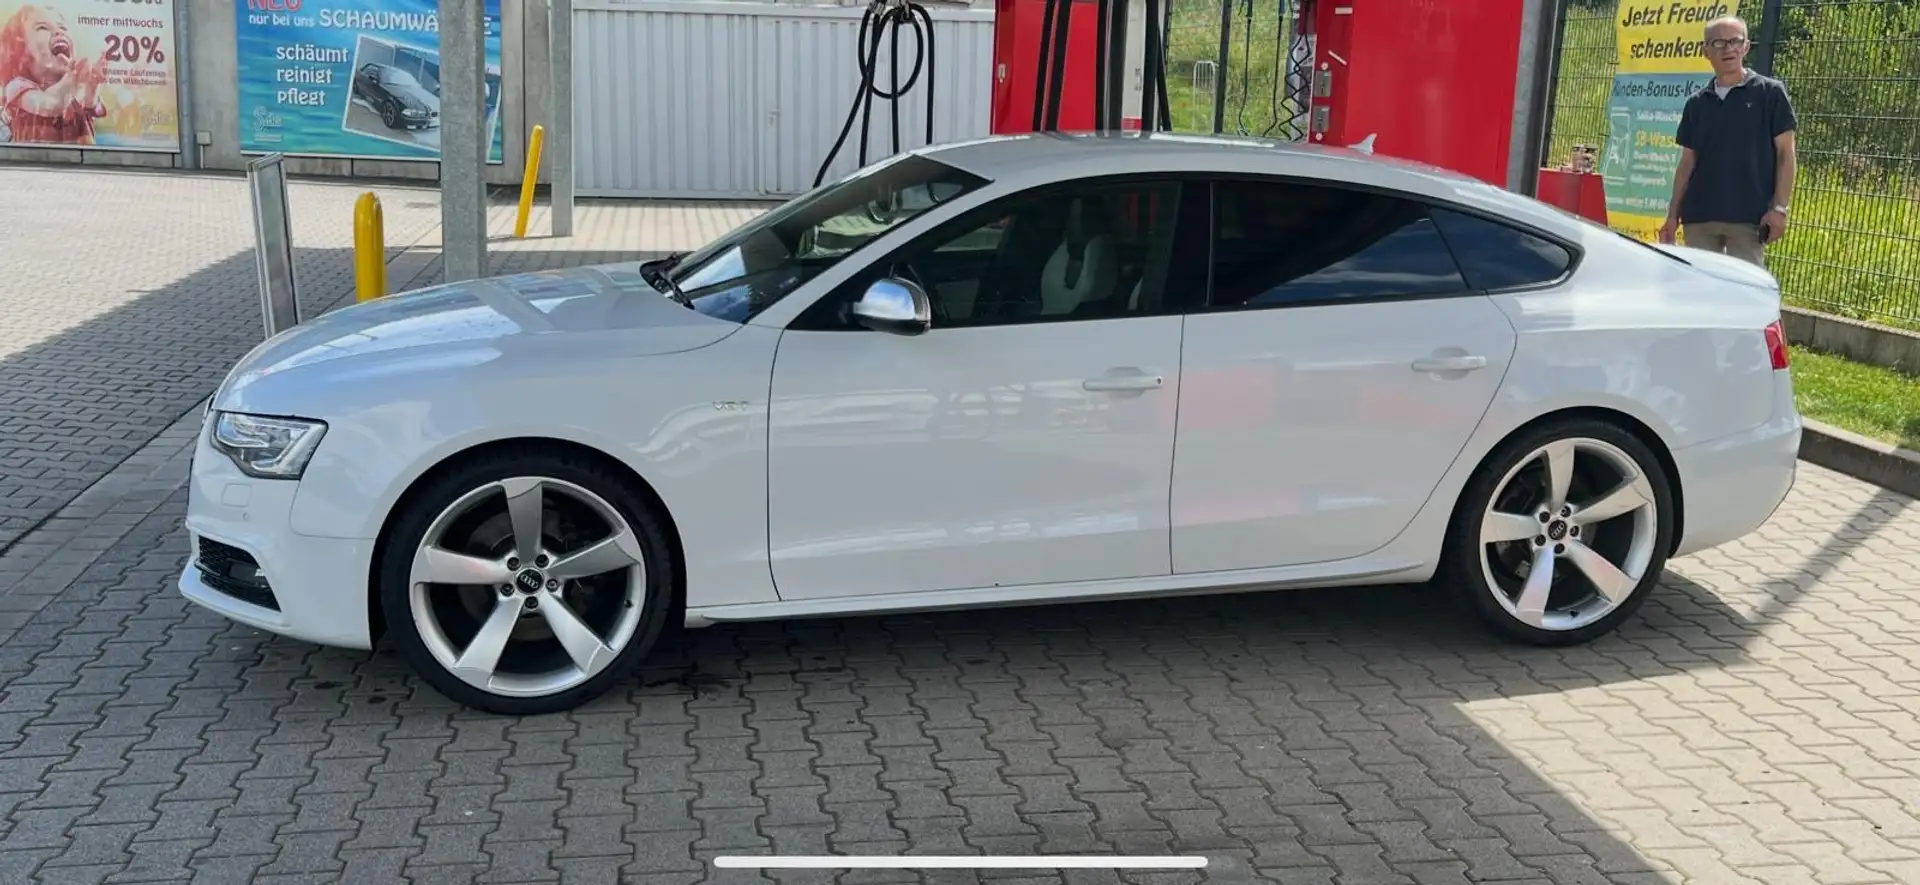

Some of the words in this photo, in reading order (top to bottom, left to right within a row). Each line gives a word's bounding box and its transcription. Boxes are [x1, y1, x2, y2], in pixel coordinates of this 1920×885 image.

[78, 15, 109, 26] immer
[112, 16, 164, 29] mittwochs
[248, 14, 269, 25] nur
[272, 12, 290, 26] bei
[293, 15, 315, 28] uns
[1622, 4, 1664, 27] Jetzt
[1667, 0, 1728, 24] Freude
[104, 34, 165, 64] 20%
[276, 44, 348, 62] schäumt
[1630, 36, 1704, 59] schenken
[276, 65, 332, 83] reinigt
[277, 87, 326, 106] pflegt
